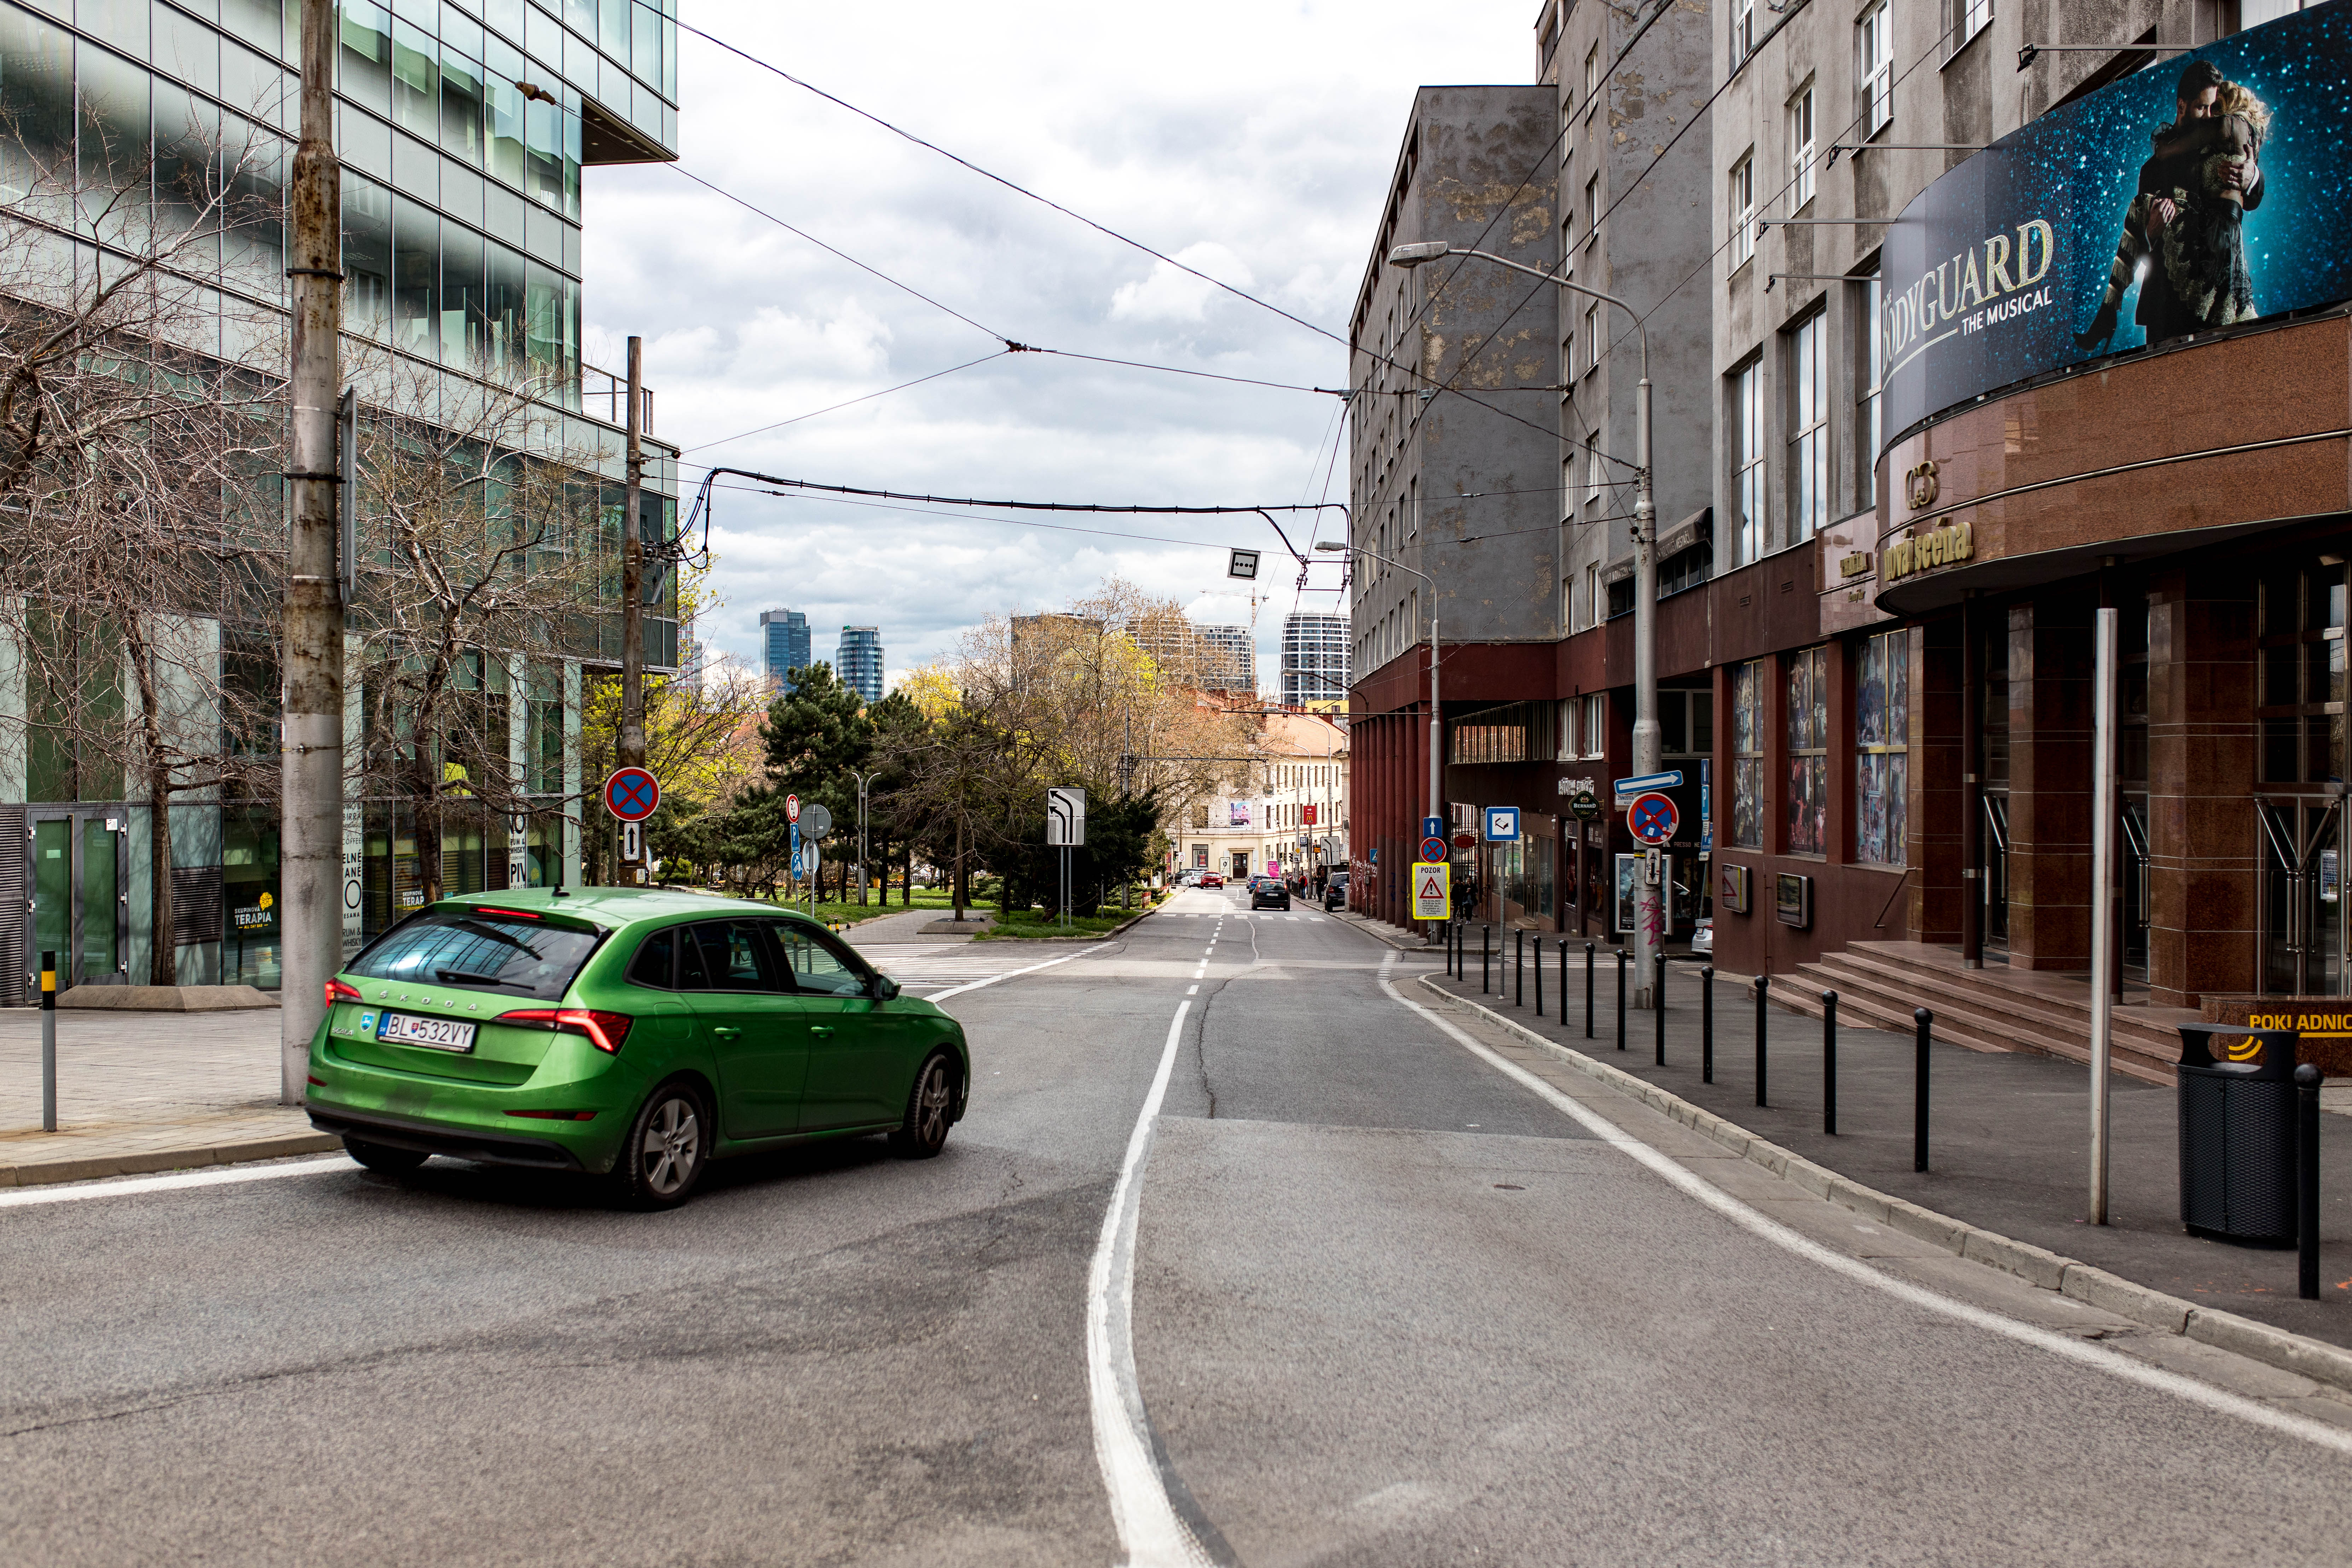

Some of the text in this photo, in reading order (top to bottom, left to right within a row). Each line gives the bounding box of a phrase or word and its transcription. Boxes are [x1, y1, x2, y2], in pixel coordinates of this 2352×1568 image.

[1882, 219, 2053, 376] BODYGUARD
[1961, 286, 2052, 336] THE MUSICAL
[1884, 528, 1914, 582] nová
[1915, 517, 1974, 571] scéna
[235, 905, 260, 914] SKUPINOVÁ
[235, 912, 272, 925] TERAPIA
[342, 927, 361, 937] RUM &
[342, 938, 362, 947] WHISKY
[380, 990, 477, 1011] ŠKODA
[332, 1027, 353, 1036] SCALA
[389, 1016, 408, 1036] BL
[417, 1020, 473, 1045] 532VY
